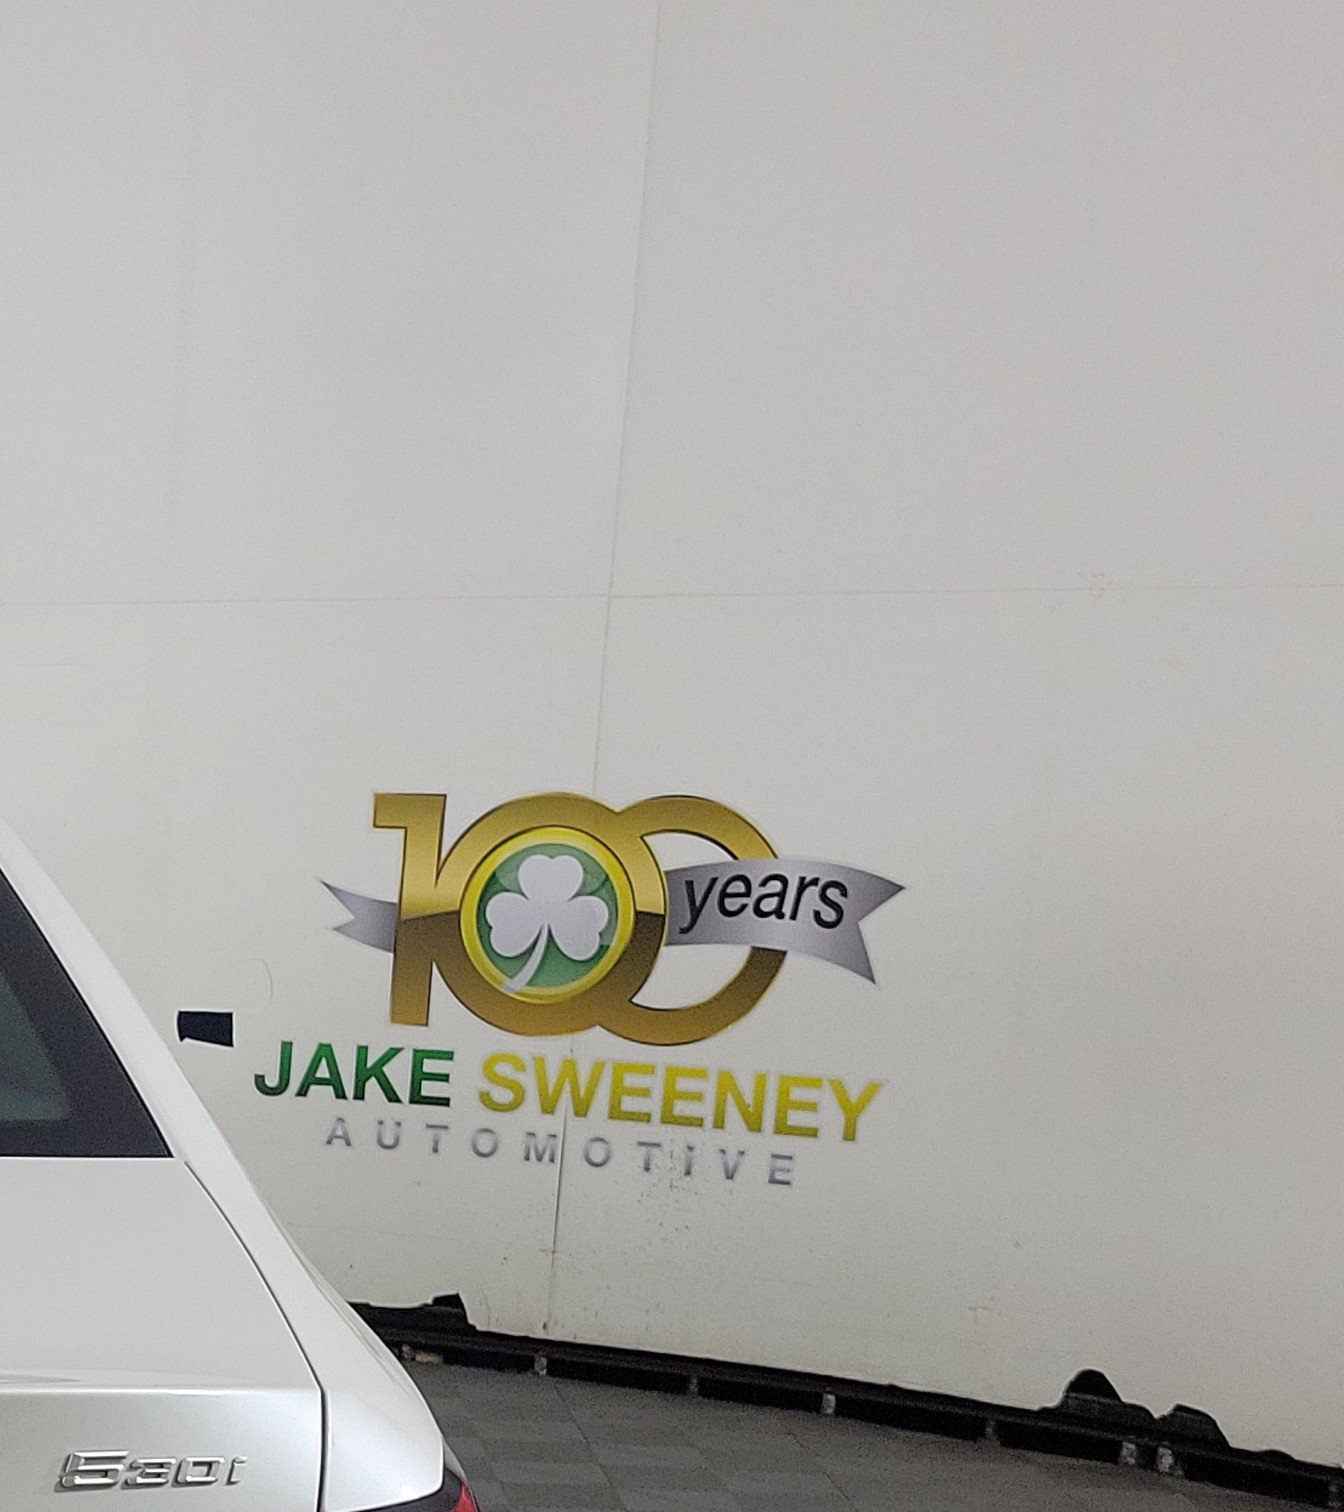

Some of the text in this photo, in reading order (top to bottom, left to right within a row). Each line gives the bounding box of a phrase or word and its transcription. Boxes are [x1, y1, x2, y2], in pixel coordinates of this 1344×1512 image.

[372, 792, 850, 1046] 100 years
[254, 1040, 883, 1141] JAKE SWEENEY
[325, 1117, 794, 1187] AUTOMOTIVE
[61, 1451, 248, 1488] 530i
